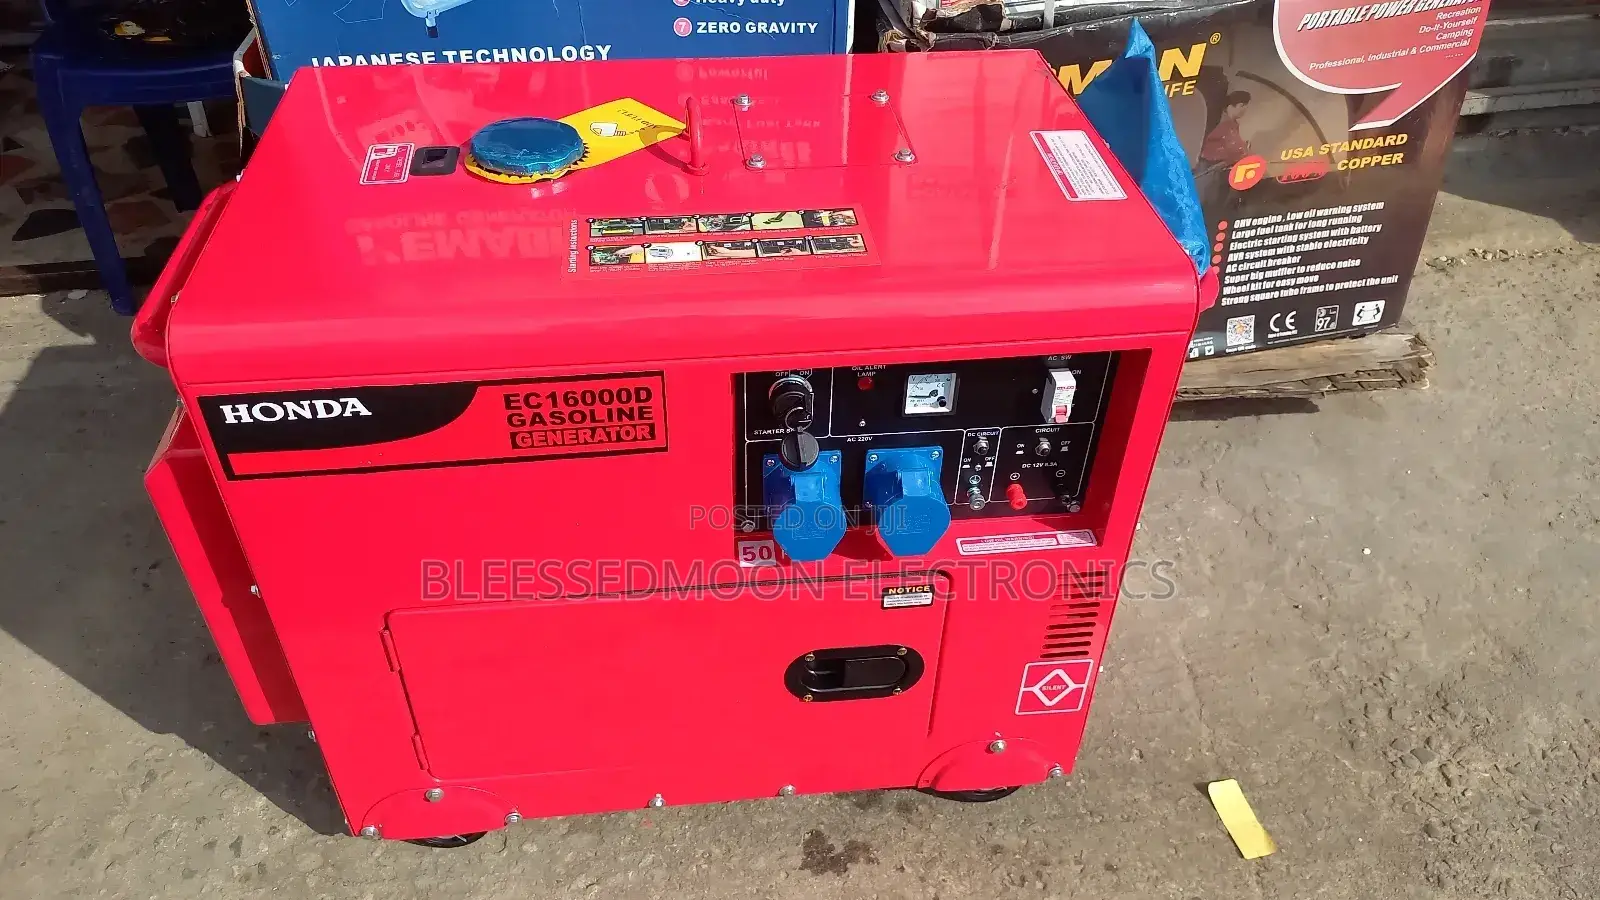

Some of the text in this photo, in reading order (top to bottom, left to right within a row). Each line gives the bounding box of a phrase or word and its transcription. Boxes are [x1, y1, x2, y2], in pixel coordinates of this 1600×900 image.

[1296, 5, 1371, 32] PORTABLE
[1419, 16, 1478, 33] Do-It-Yourself
[1436, 6, 1481, 20] Recreation
[697, 22, 741, 34] ZERO
[745, 22, 818, 34] GRAVITY
[1436, 28, 1474, 40] Camping
[311, 44, 612, 67] JAPANESE TECHNOLOGY
[1309, 38, 1471, 70] Professional, Industrial & Commercial
[1280, 133, 1408, 161] USA STANDARD
[1337, 152, 1404, 171] COPPER
[1285, 211, 1304, 221] Low
[1316, 205, 1353, 217] warning
[1352, 201, 1385, 213] system
[1229, 223, 1383, 251] Electric starting system with battery
[1231, 214, 1363, 239] Large fuel tank for long running
[1244, 248, 1276, 260] system
[1276, 244, 1296, 255] with
[1296, 240, 1323, 253] stable
[1323, 236, 1370, 249] electricity
[1224, 258, 1362, 285] Super big muffler to reduce noise
[1225, 255, 1302, 274] AC circuit breaker
[1221, 295, 1250, 307] Strong
[1249, 290, 1280, 302] square
[1299, 284, 1325, 295] frame
[1325, 283, 1335, 292] to
[1334, 279, 1367, 291] protect
[1366, 277, 1381, 287] the
[1380, 274, 1399, 285] unit
[1222, 283, 1250, 295] Wheel
[1261, 280, 1276, 290] for
[1275, 277, 1297, 288] easy
[1296, 274, 1320, 285] move
[1317, 317, 1331, 330] 97
[219, 397, 372, 424] HONDA
[503, 387, 653, 411] EC16000D
[506, 405, 653, 428] GASOLINE
[515, 425, 652, 448] GENERATOR
[742, 546, 772, 561] 50
[888, 585, 931, 594] NOTICE
